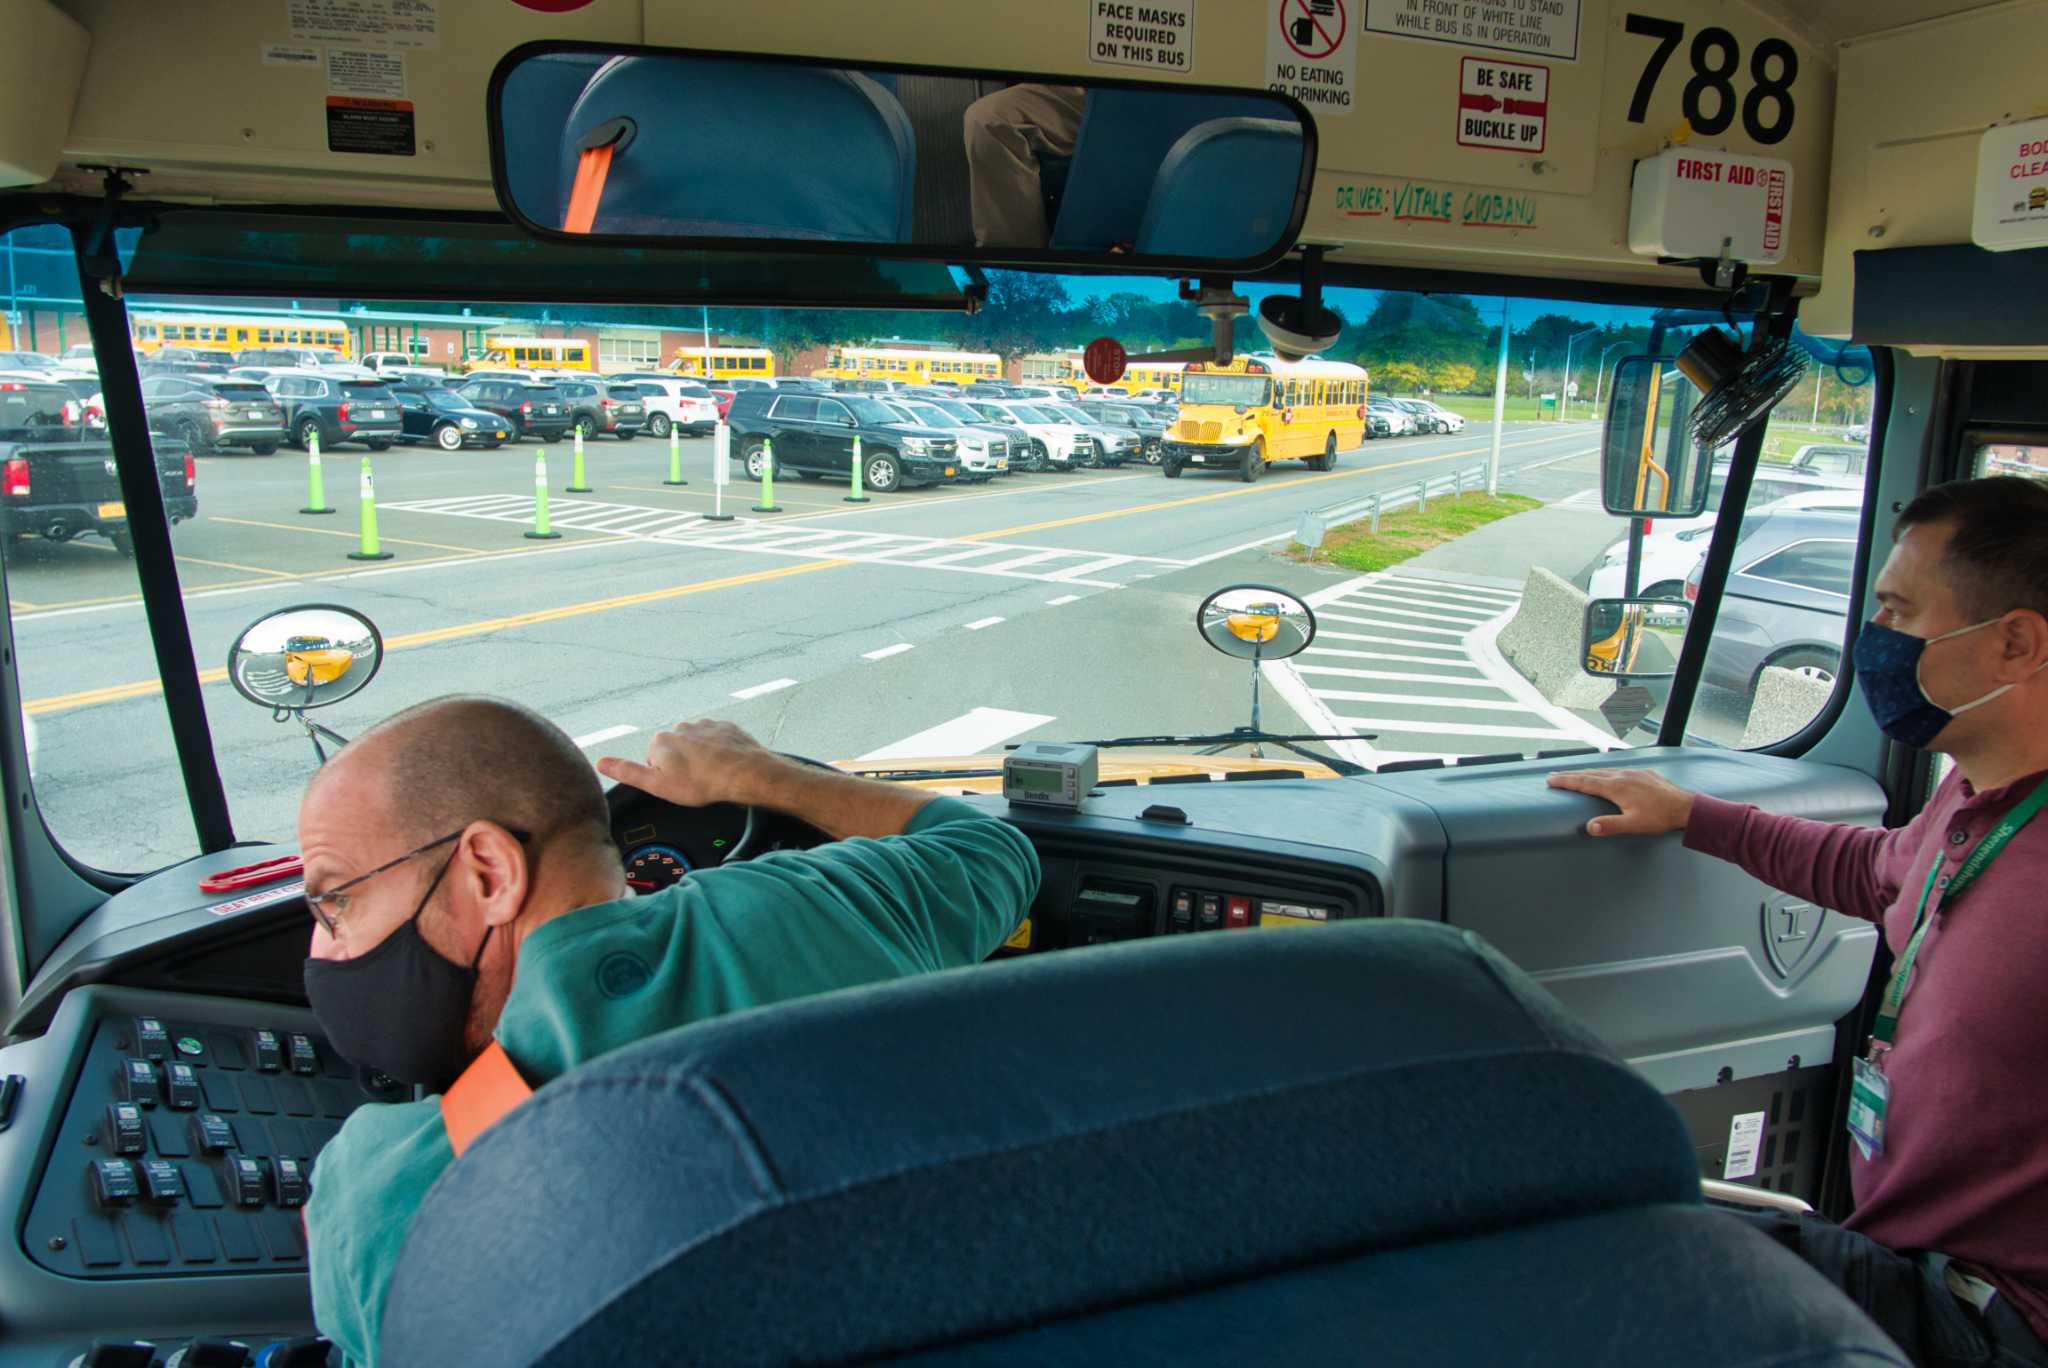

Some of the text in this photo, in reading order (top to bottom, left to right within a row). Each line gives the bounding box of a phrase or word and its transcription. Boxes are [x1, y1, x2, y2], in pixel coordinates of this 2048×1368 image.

[1098, 2, 1186, 28] FACE MASKS
[1406, 0, 1417, 11] IN
[1422, 0, 1459, 17] FRONT
[1464, 5, 1478, 19] OF
[1482, 9, 1515, 27] WHITE
[1519, 14, 1542, 31] LINE
[1530, 1, 1564, 16] STAND
[1106, 23, 1177, 45] REQUIRED
[1396, 14, 1551, 48] WHILE BUS IS IN OPERATION
[1096, 42, 1185, 66] ON THIS BUS
[1277, 63, 1345, 86] NO EATING
[1477, 68, 1533, 92] BE SAFE
[1625, 13, 1799, 145] 788
[1292, 86, 1351, 106] DRINKING
[1465, 119, 1538, 143] BUCKLE UP
[1676, 159, 1755, 186] FIRST AID
[1393, 182, 1453, 218] VITALE
[1763, 170, 1785, 250] FIRST AID
